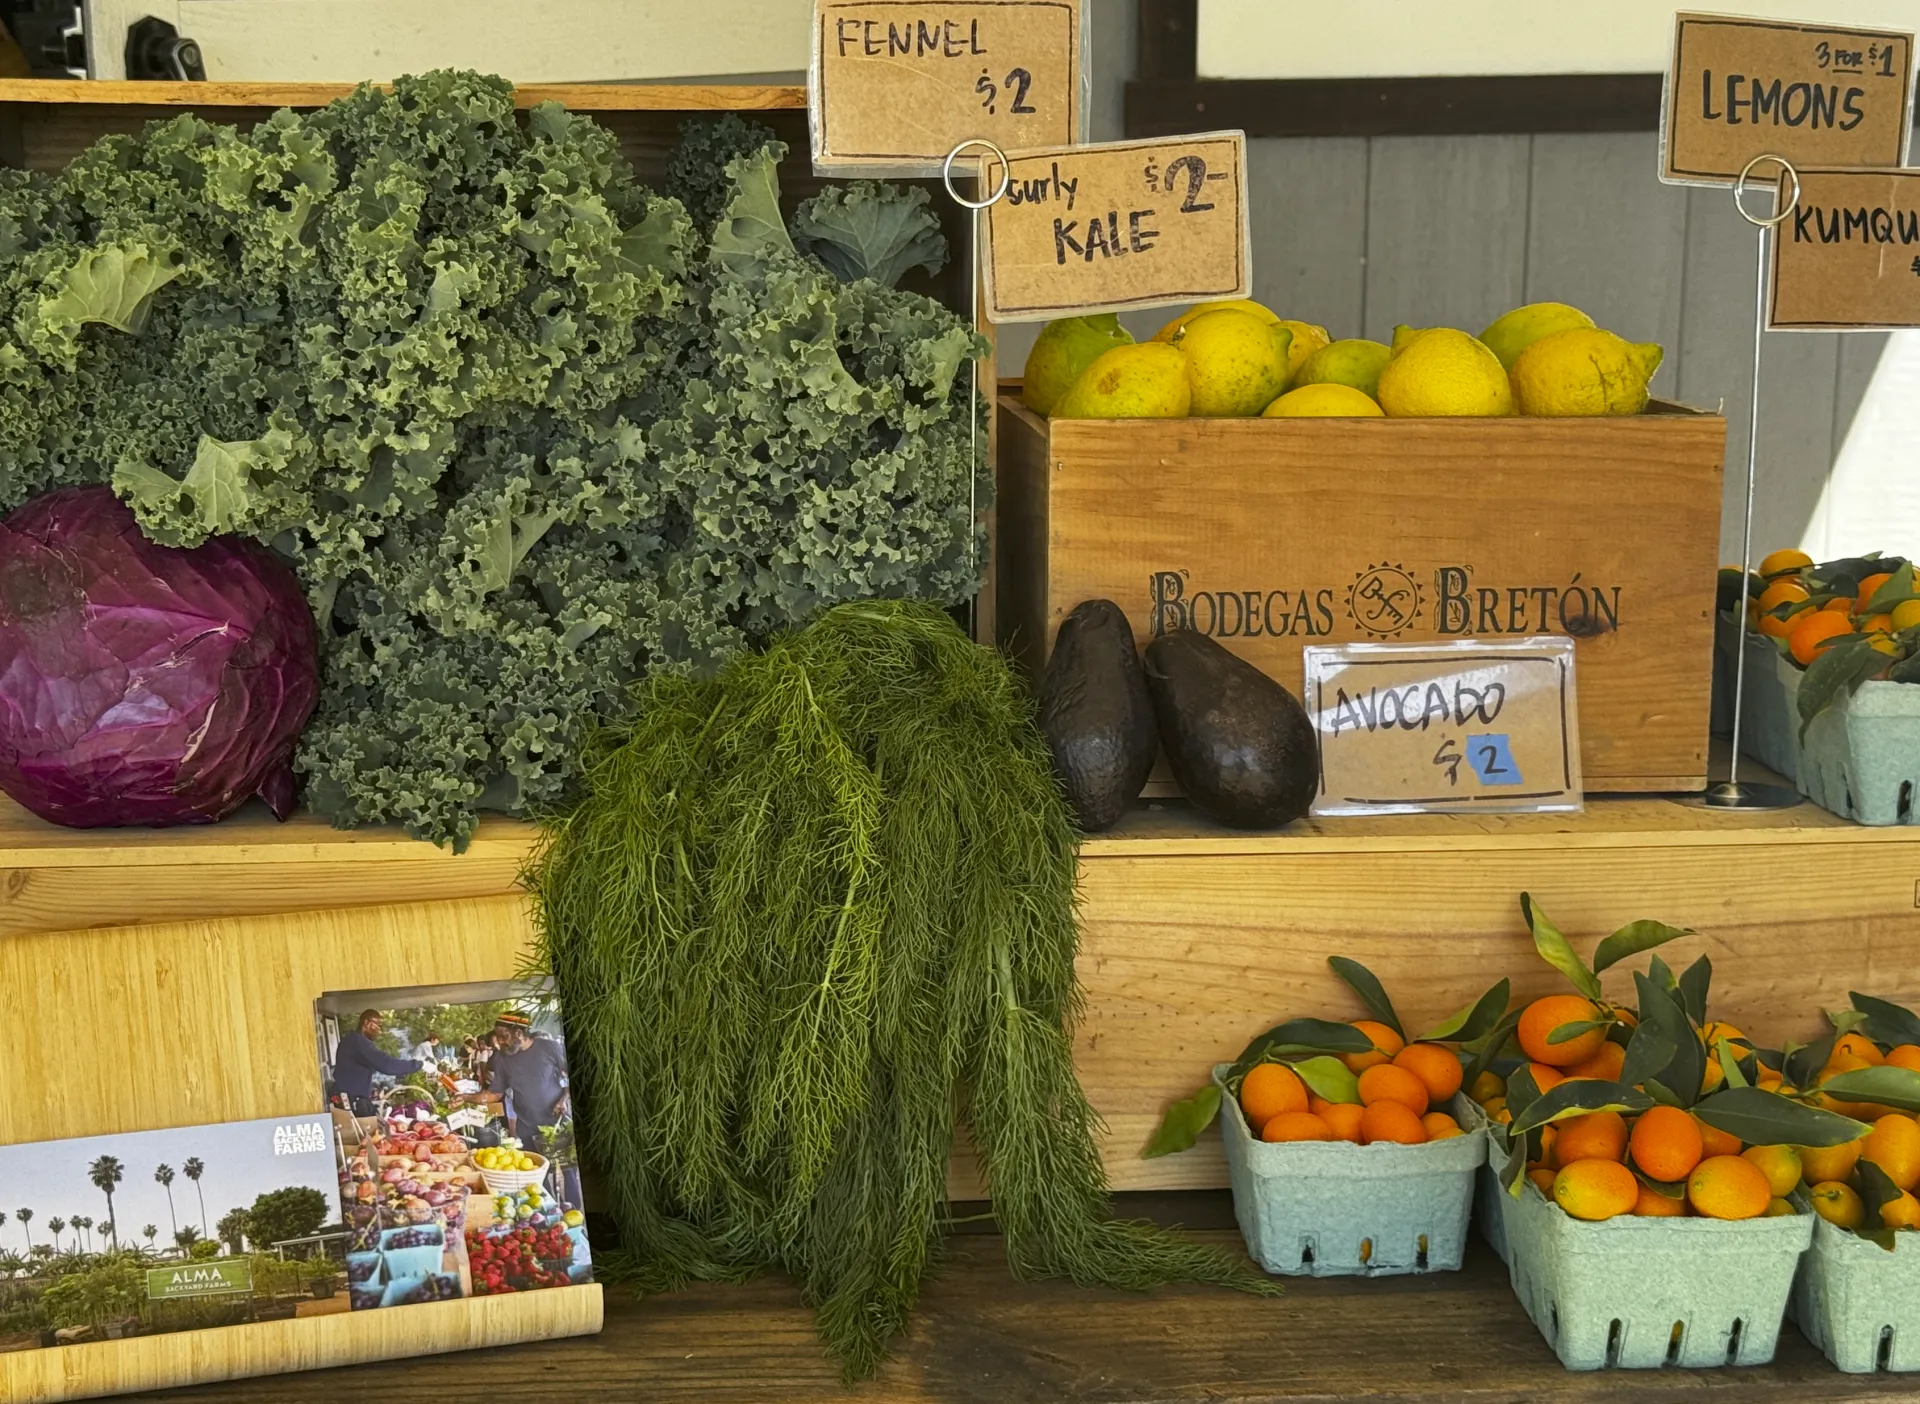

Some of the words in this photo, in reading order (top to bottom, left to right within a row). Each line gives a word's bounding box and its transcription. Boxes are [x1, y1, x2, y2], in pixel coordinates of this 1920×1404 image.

[837, 18, 987, 58] FENNEL
[1815, 41, 1831, 69] 3
[1834, 49, 1863, 68] FOR
[975, 68, 1037, 115] $2
[1702, 69, 1865, 132] LEMONS
[1053, 209, 1161, 265] KALE
[1331, 680, 1507, 739] AVOCADO
[274, 1122, 324, 1138] ALMA
[274, 1140, 327, 1155] FARMS
[165, 1283, 204, 1293] BACKYARD
[204, 1281, 232, 1290] FARMS
[171, 1267, 223, 1284] ALMA
